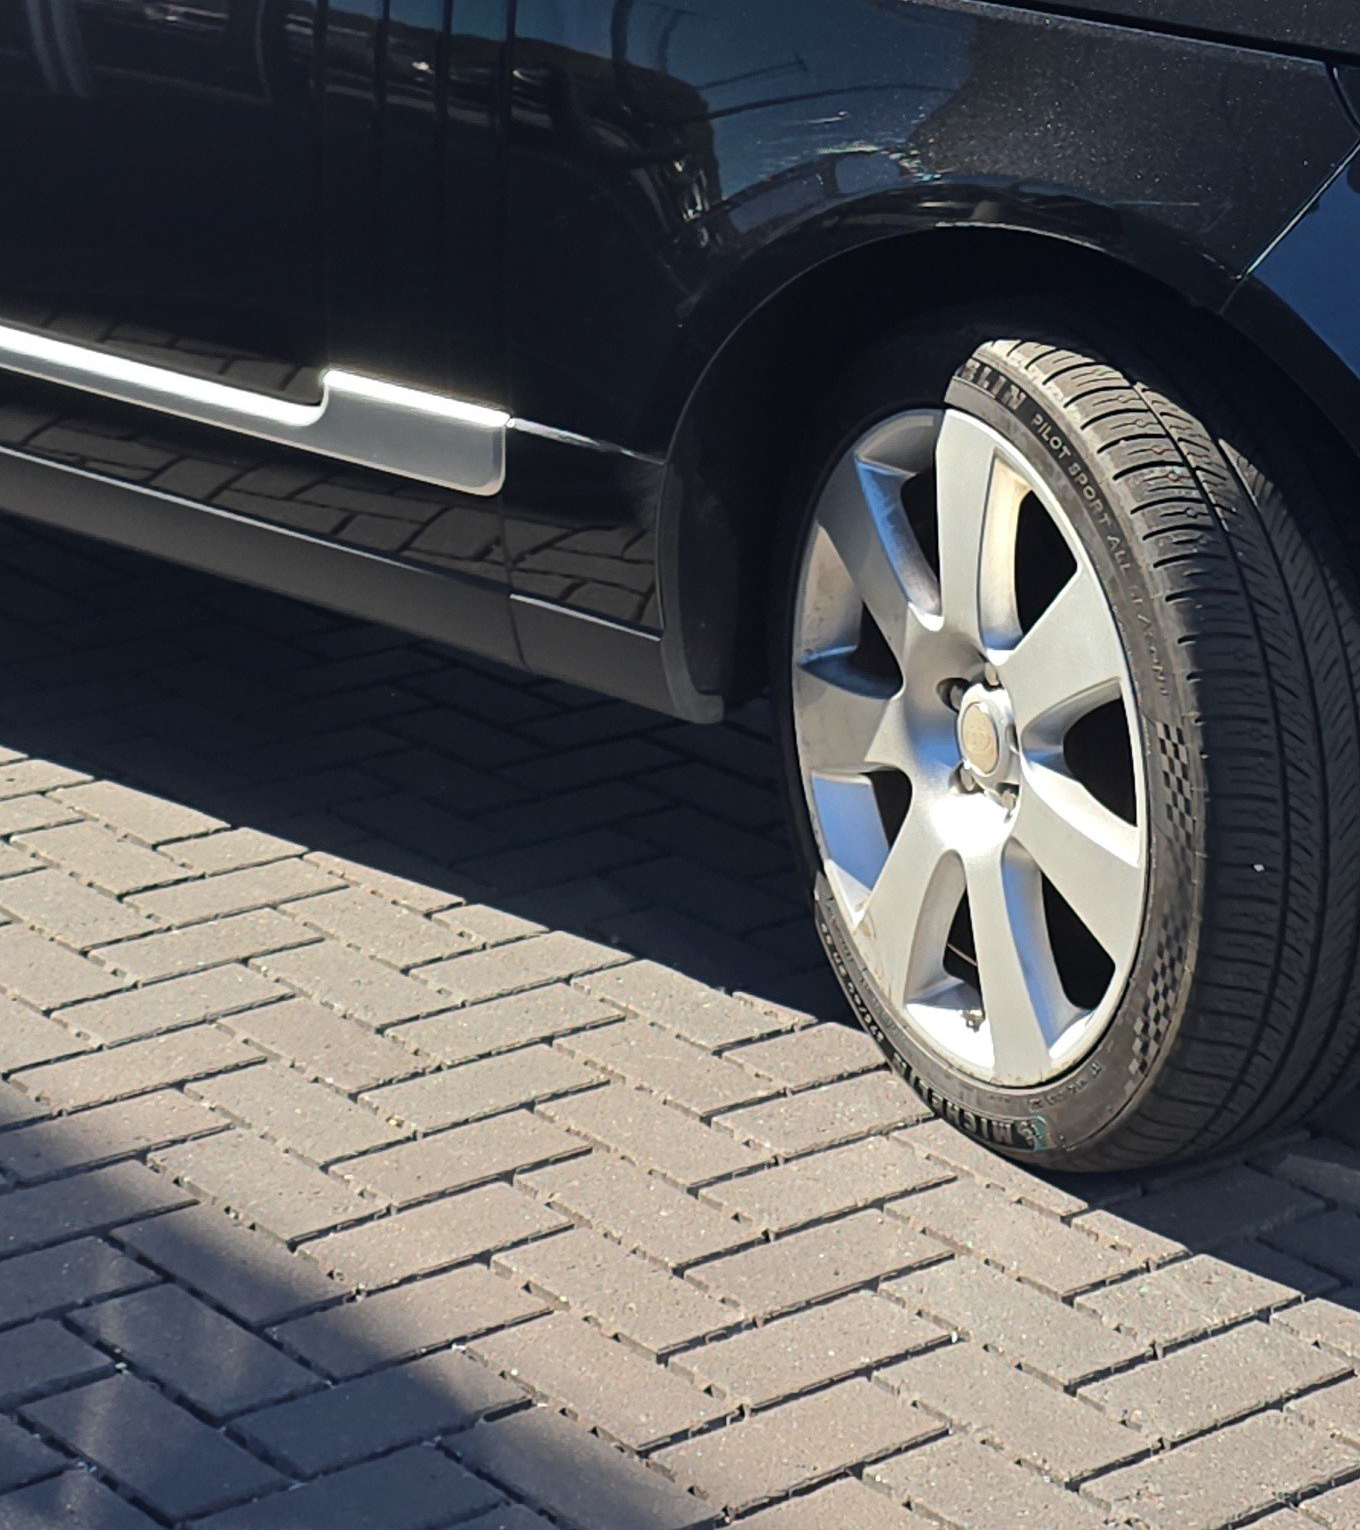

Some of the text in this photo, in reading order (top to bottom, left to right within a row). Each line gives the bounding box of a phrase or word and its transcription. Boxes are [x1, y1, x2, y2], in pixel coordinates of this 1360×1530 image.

[960, 358, 1132, 576] ELIN PILOT SPORT ALL
